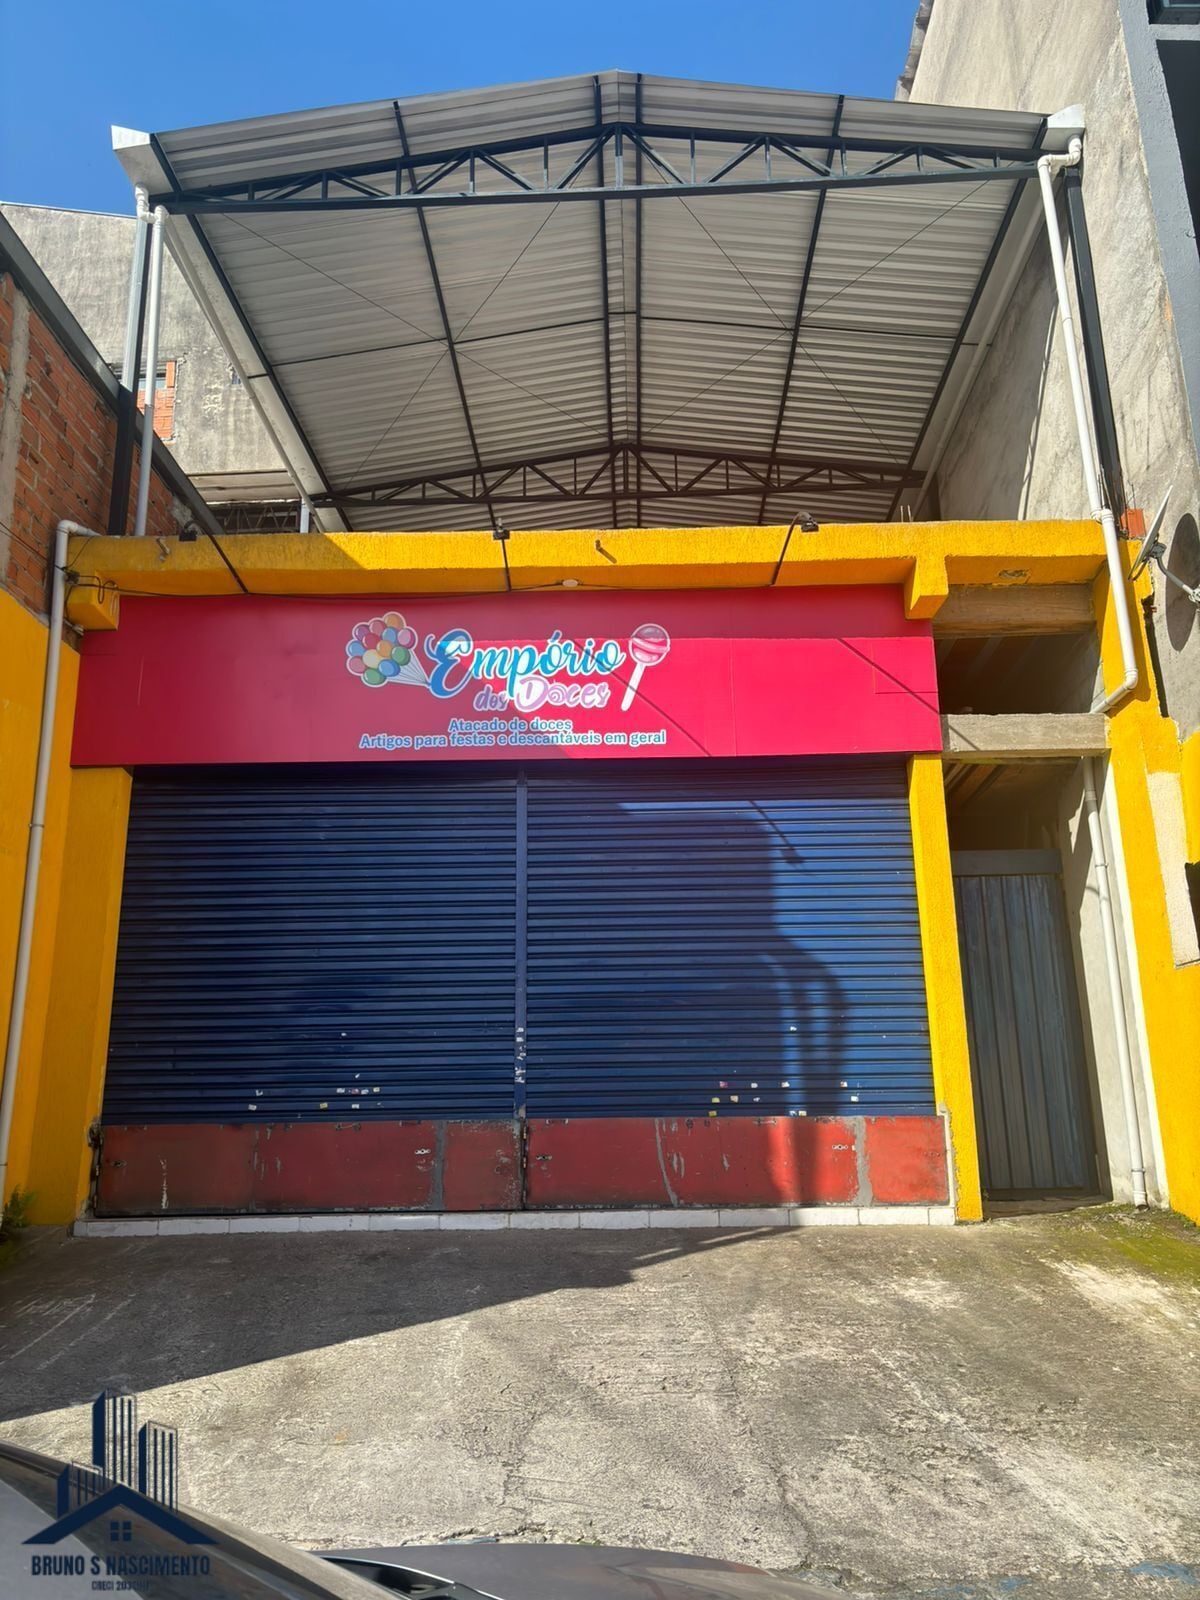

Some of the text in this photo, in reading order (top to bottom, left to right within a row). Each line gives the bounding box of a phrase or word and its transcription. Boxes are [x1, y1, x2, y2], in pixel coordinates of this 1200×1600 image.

[424, 628, 625, 699] Empório
[473, 675, 611, 712] dos Doces
[448, 717, 573, 732] Atacado de doces
[359, 733, 412, 750] Artigos
[414, 735, 447, 750] para
[450, 732, 495, 747] festas
[497, 734, 508, 746] e
[604, 731, 630, 745] em
[629, 729, 667, 747] geral
